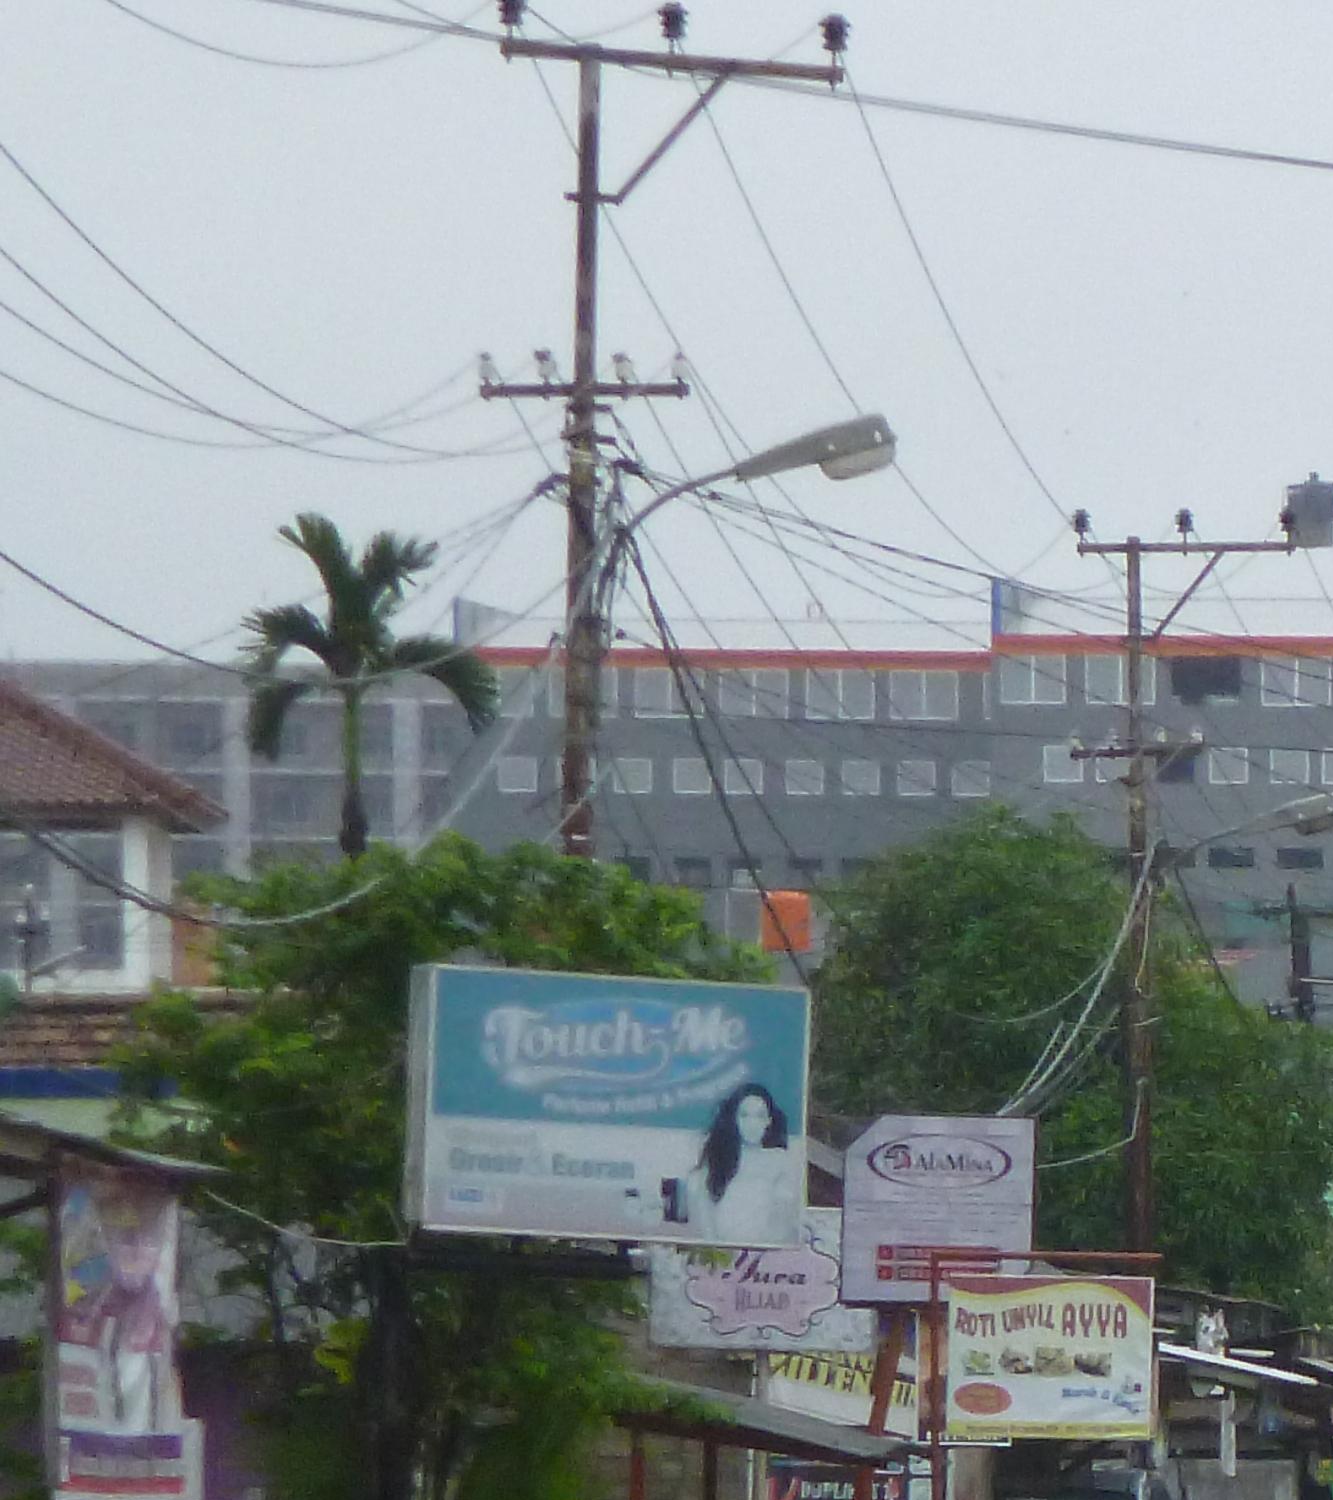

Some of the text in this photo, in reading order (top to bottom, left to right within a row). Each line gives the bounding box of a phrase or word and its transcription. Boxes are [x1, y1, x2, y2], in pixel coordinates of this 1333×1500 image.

[954, 1302, 1128, 1339] ROTI UNYIL AYYA
